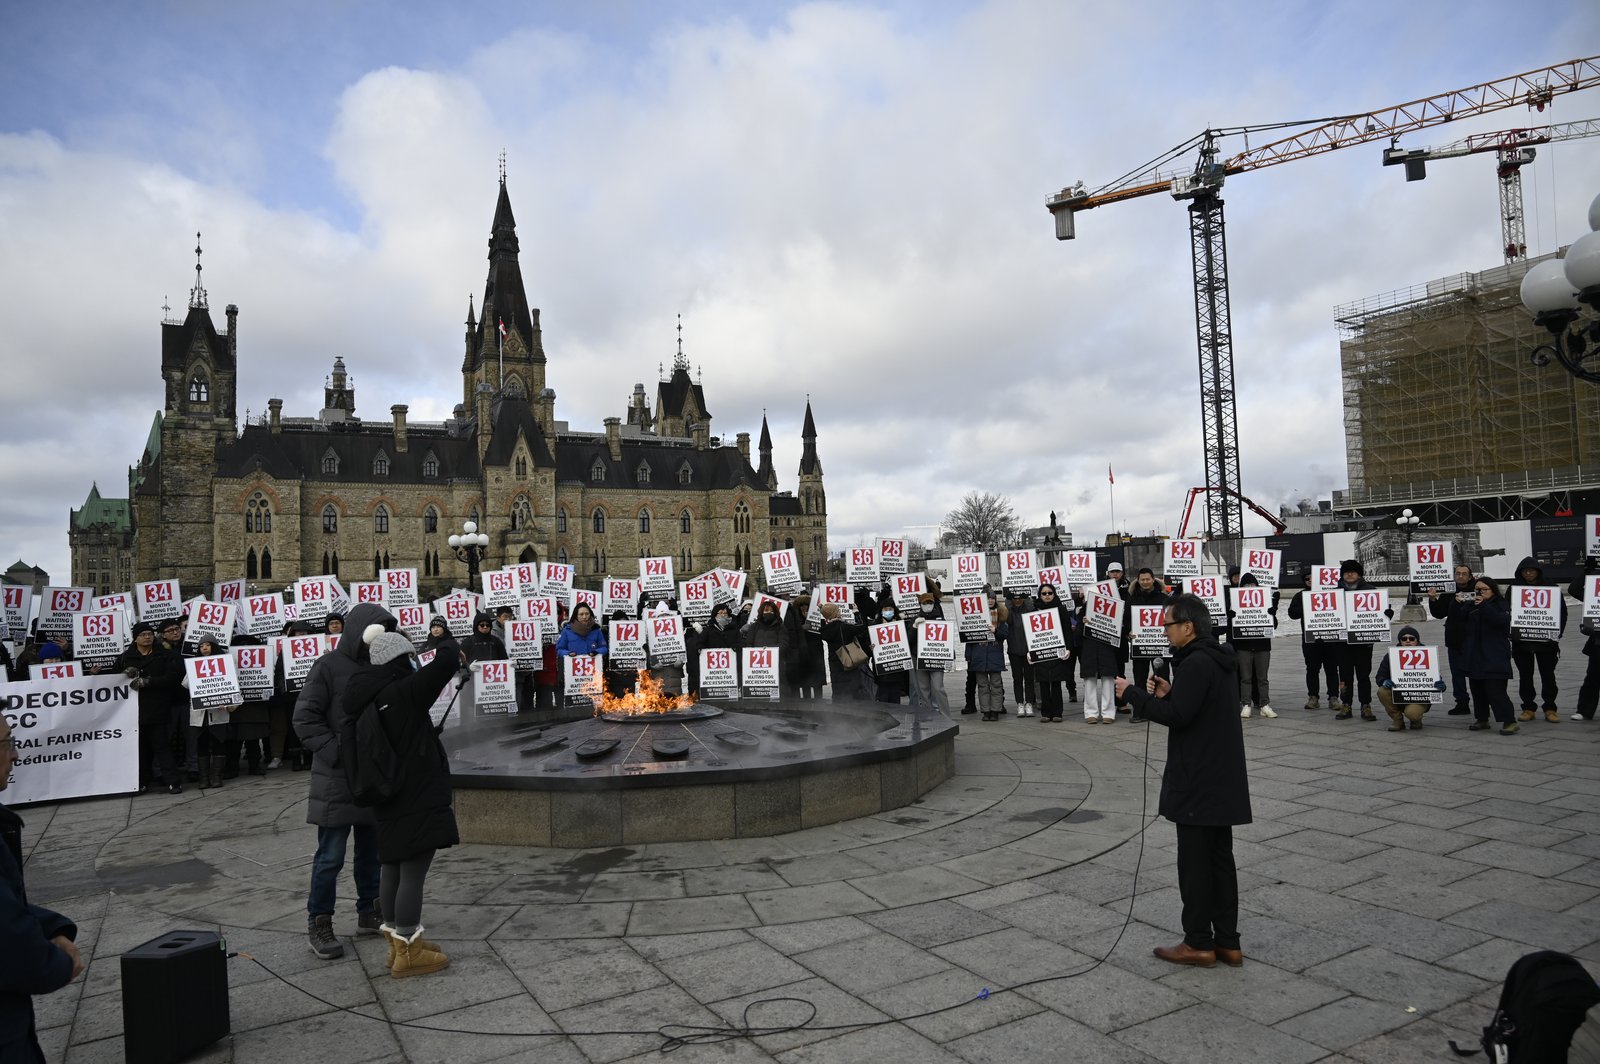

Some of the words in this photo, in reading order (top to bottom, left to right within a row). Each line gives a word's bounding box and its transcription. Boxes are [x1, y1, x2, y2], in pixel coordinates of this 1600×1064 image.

[854, 549, 870, 564] 36
[884, 541, 900, 556] 28
[1174, 542, 1192, 557] 32
[1420, 544, 1440, 562] 37
[648, 559, 664, 574] 27
[771, 552, 788, 568] 70
[960, 556, 976, 572] 90
[1009, 552, 1026, 569] 39
[1072, 554, 1087, 567] 37
[1252, 552, 1271, 568] 30
[390, 572, 407, 588] 38
[492, 572, 510, 590] 65
[548, 565, 564, 580] 18
[1042, 569, 1060, 585] 32
[148, 583, 169, 602] 34
[224, 583, 238, 602] 27
[304, 582, 321, 601] 33
[612, 582, 628, 597] 63
[688, 583, 704, 599] 35
[900, 577, 916, 593] 37
[1194, 579, 1214, 596] 38
[56, 592, 79, 610] 68
[360, 586, 380, 602] 34
[829, 587, 845, 602] 31
[1242, 589, 1260, 607] 40
[1313, 592, 1333, 611] 31
[1356, 593, 1376, 611] 20
[1524, 589, 1547, 607] 30
[200, 604, 224, 624] 39
[253, 596, 273, 615] 27
[450, 602, 467, 618] 55
[531, 600, 548, 616] 62
[962, 597, 980, 614] 31
[1096, 597, 1114, 616] 37
[86, 614, 110, 635] 68
[403, 608, 420, 625] 30
[1032, 612, 1051, 631] 37
[1143, 608, 1160, 626] 37
[514, 622, 532, 640] 40
[619, 623, 635, 640] 72
[656, 618, 674, 636] 23
[879, 625, 897, 644] 37
[928, 624, 944, 640] 37
[294, 638, 315, 658] 33
[198, 657, 222, 677] 41
[240, 649, 262, 668] 81
[709, 651, 726, 668] 36
[752, 650, 768, 667] 21
[1402, 650, 1425, 669] 22
[485, 663, 504, 683] 34
[7, 684, 129, 710] DECISION
[206, 686, 236, 694] RESPONSE
[48, 729, 122, 746] FAIRNESS
